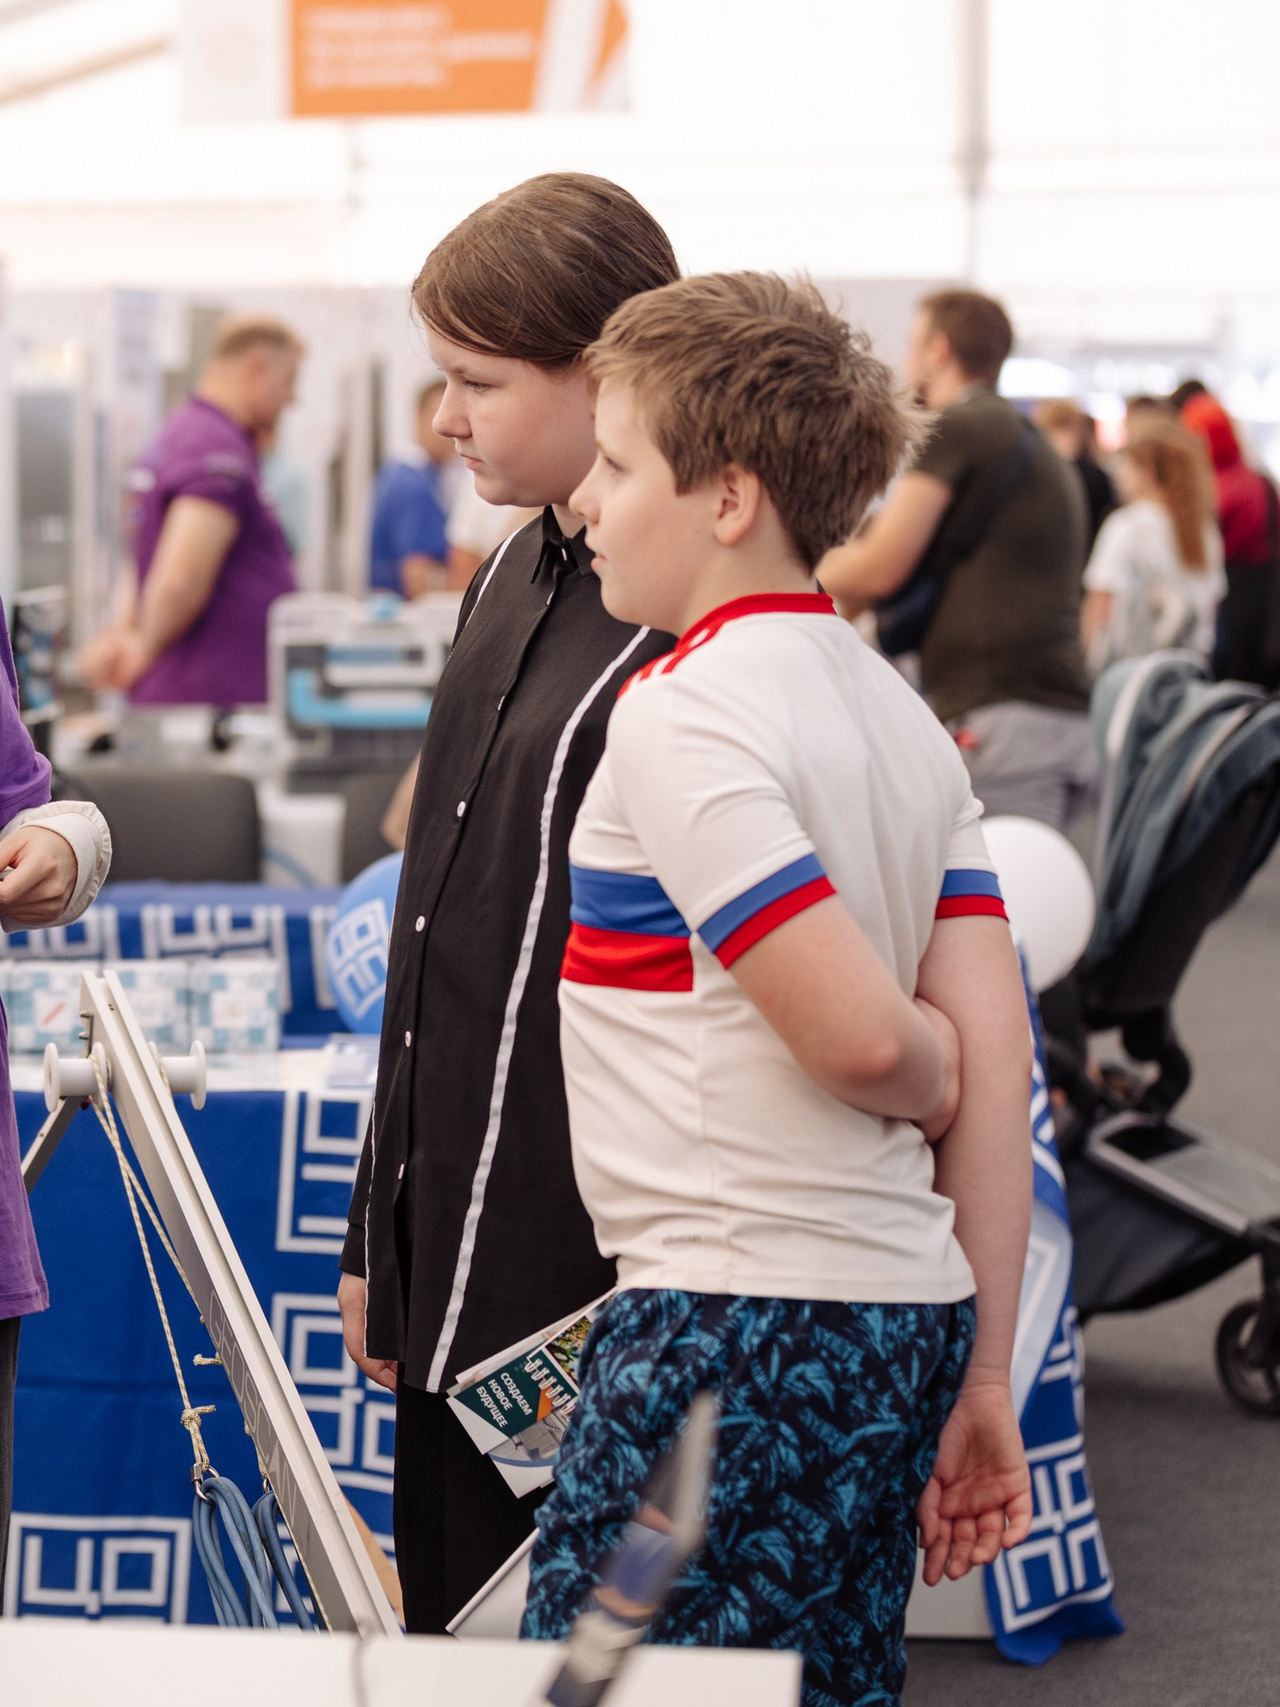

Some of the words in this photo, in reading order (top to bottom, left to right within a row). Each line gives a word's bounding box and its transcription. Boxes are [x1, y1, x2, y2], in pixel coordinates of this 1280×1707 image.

[209, 1288, 297, 1529] GEOSCAN
[476, 1386, 508, 1428] БУДУЩЕЕ
[488, 1379, 513, 1411] НОВОЕ
[500, 1372, 533, 1416] СОЗДАЕМ
